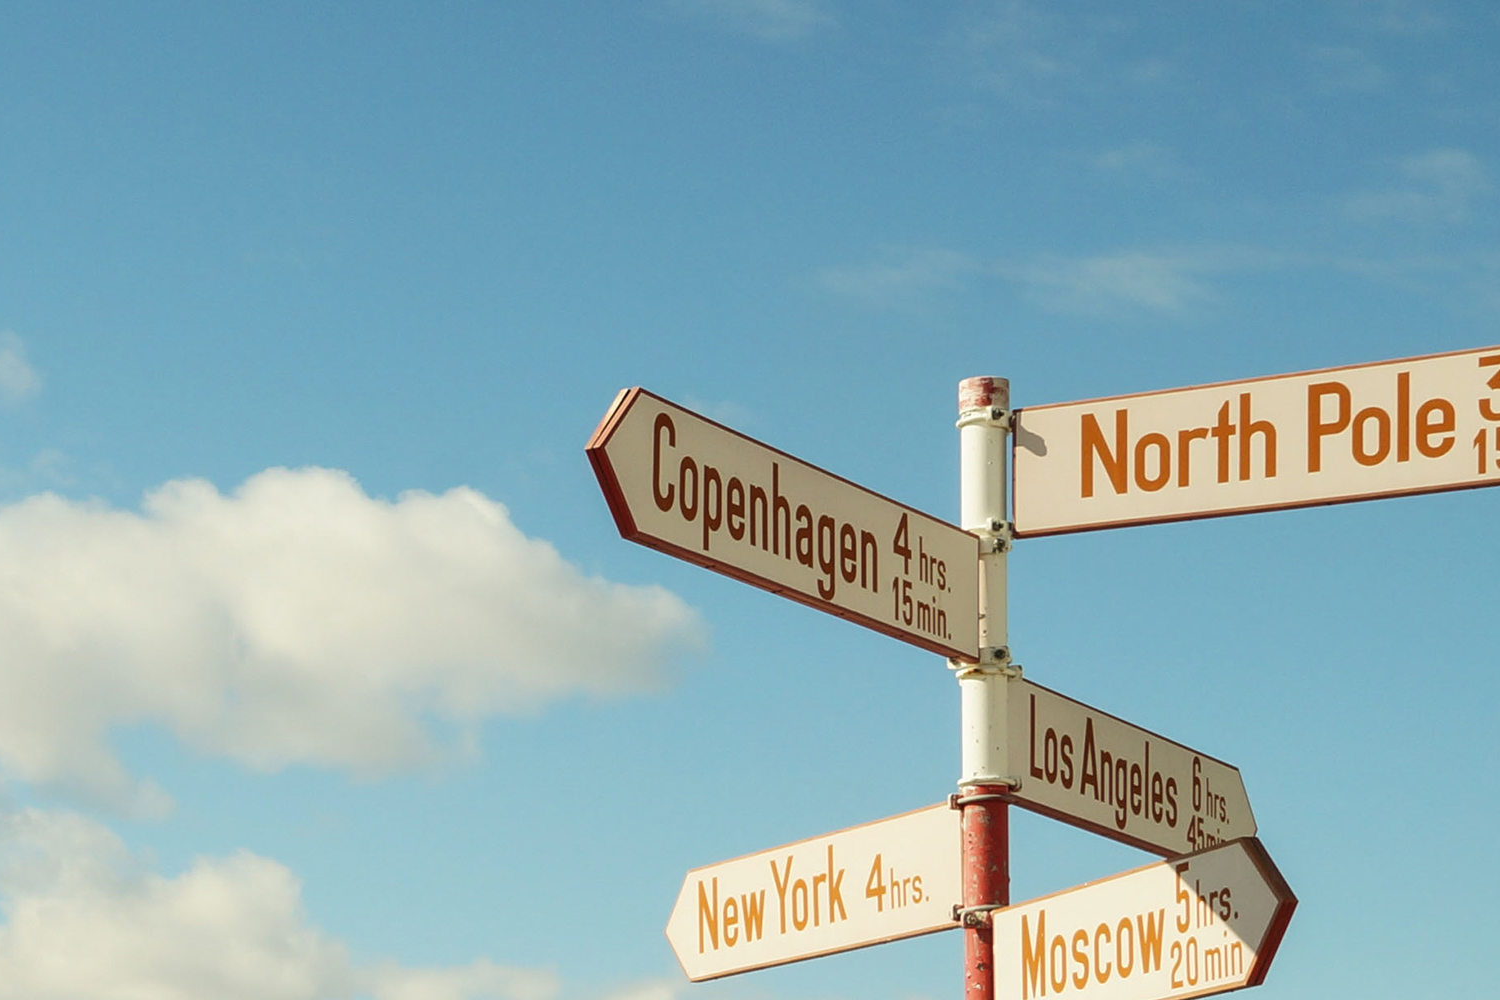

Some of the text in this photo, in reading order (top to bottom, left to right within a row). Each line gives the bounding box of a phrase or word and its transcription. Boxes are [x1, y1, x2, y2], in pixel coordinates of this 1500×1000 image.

[1081, 392, 1277, 498] North
[1307, 371, 1456, 473] Pole
[652, 412, 952, 600] Copenhagen 4 hrs.
[892, 576, 952, 640] 15 min.
[1030, 693, 1229, 829] Los Angeles 6 hrs.
[1187, 815, 1204, 852] 45
[698, 844, 929, 954] New York 4 hrs.
[1021, 862, 1238, 1000] Moscow 5 hrs.
[1170, 930, 1243, 989] 20 min
